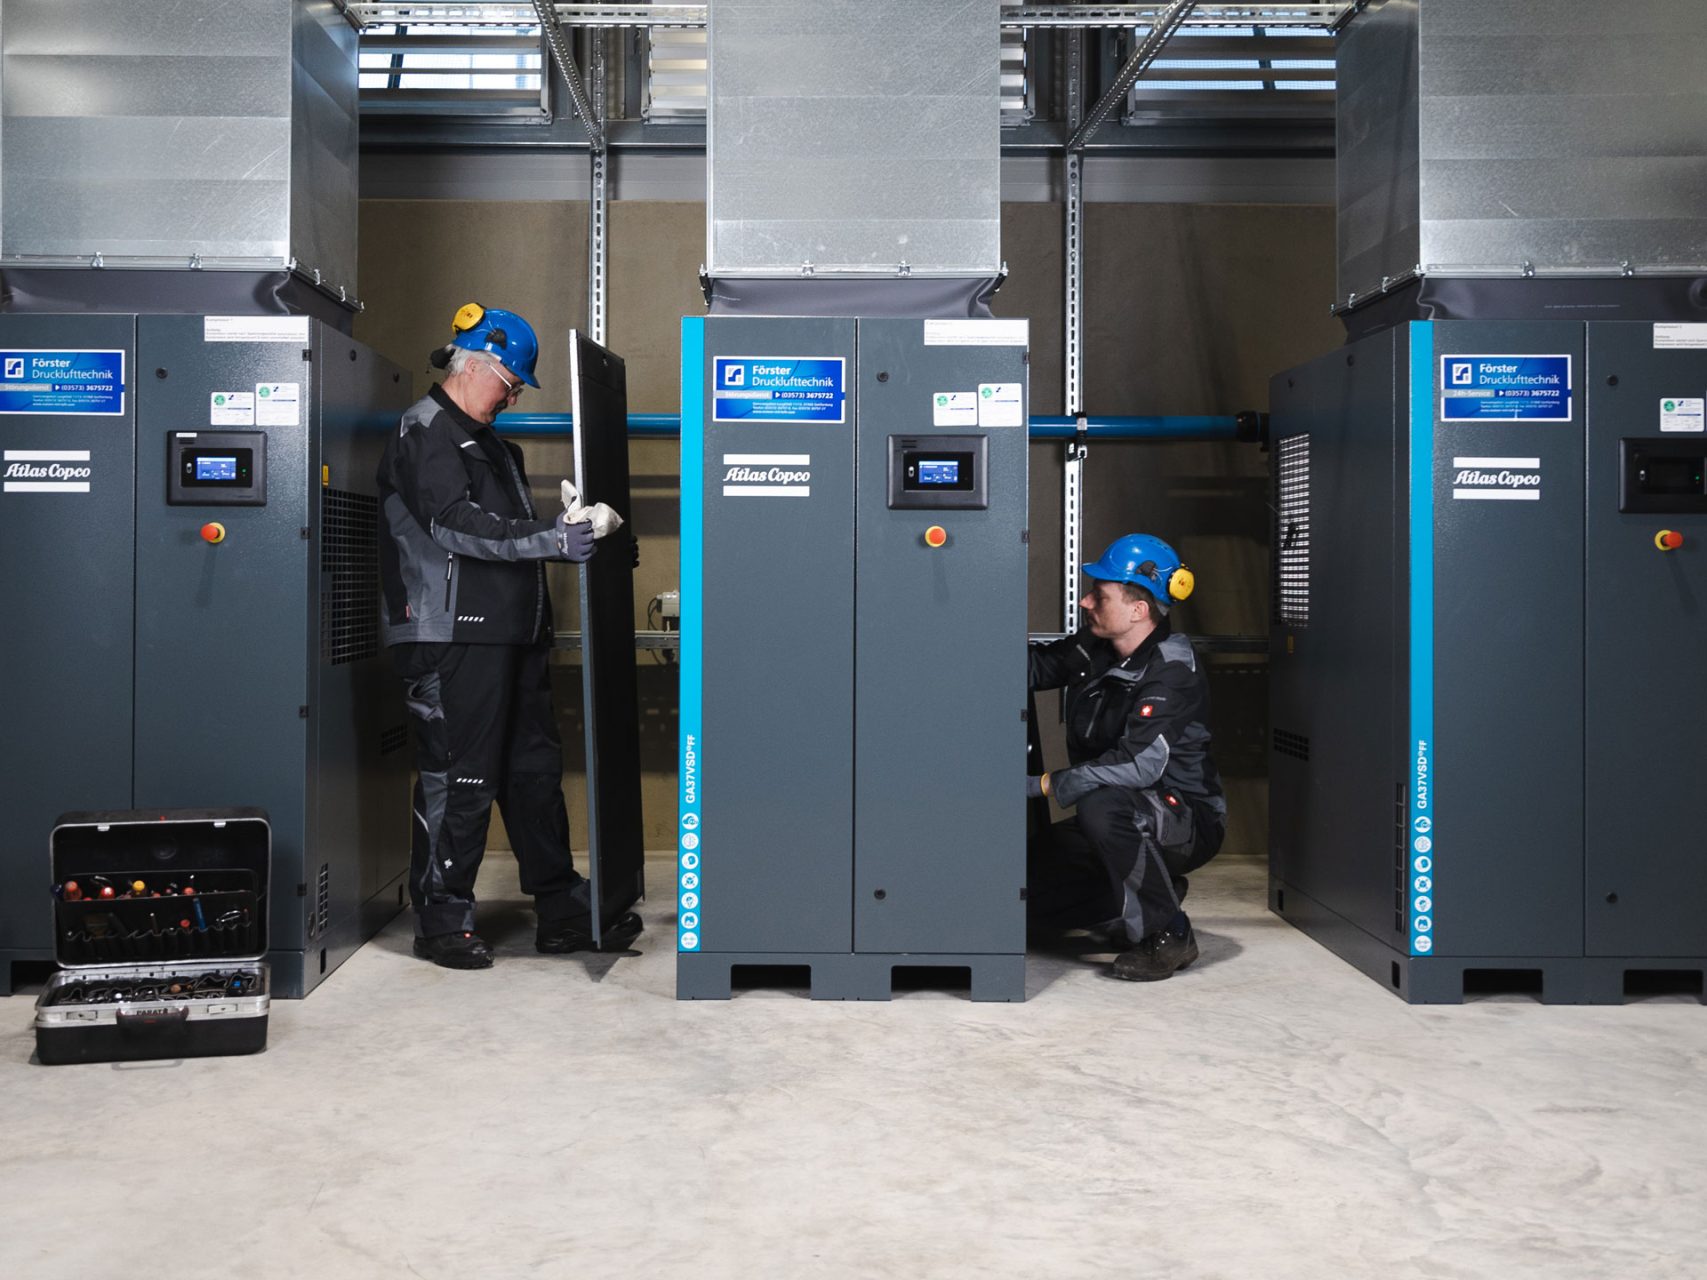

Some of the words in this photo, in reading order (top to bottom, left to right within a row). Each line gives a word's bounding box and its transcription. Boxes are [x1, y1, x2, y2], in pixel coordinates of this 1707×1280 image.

[32, 358, 70, 368] Förster
[752, 365, 791, 375] Förster
[1480, 364, 1518, 373] Förster
[32, 369, 113, 380] Drucklufttechnik
[1480, 374, 1560, 385] Drucklufttechnik
[752, 376, 833, 387] Drucklufttechnik
[61, 384, 85, 392] (03573)
[86, 384, 113, 392] 3675722
[1505, 389, 1530, 397] (03573)
[1531, 389, 1560, 397] 3675722
[781, 391, 805, 399] (03573)
[3, 463, 48, 478] Atlas
[48, 463, 91, 480] Copco
[723, 467, 767, 482] Atlas
[768, 467, 811, 485] Copco
[1453, 470, 1497, 485] Atlas
[1498, 470, 1541, 488] Copco
